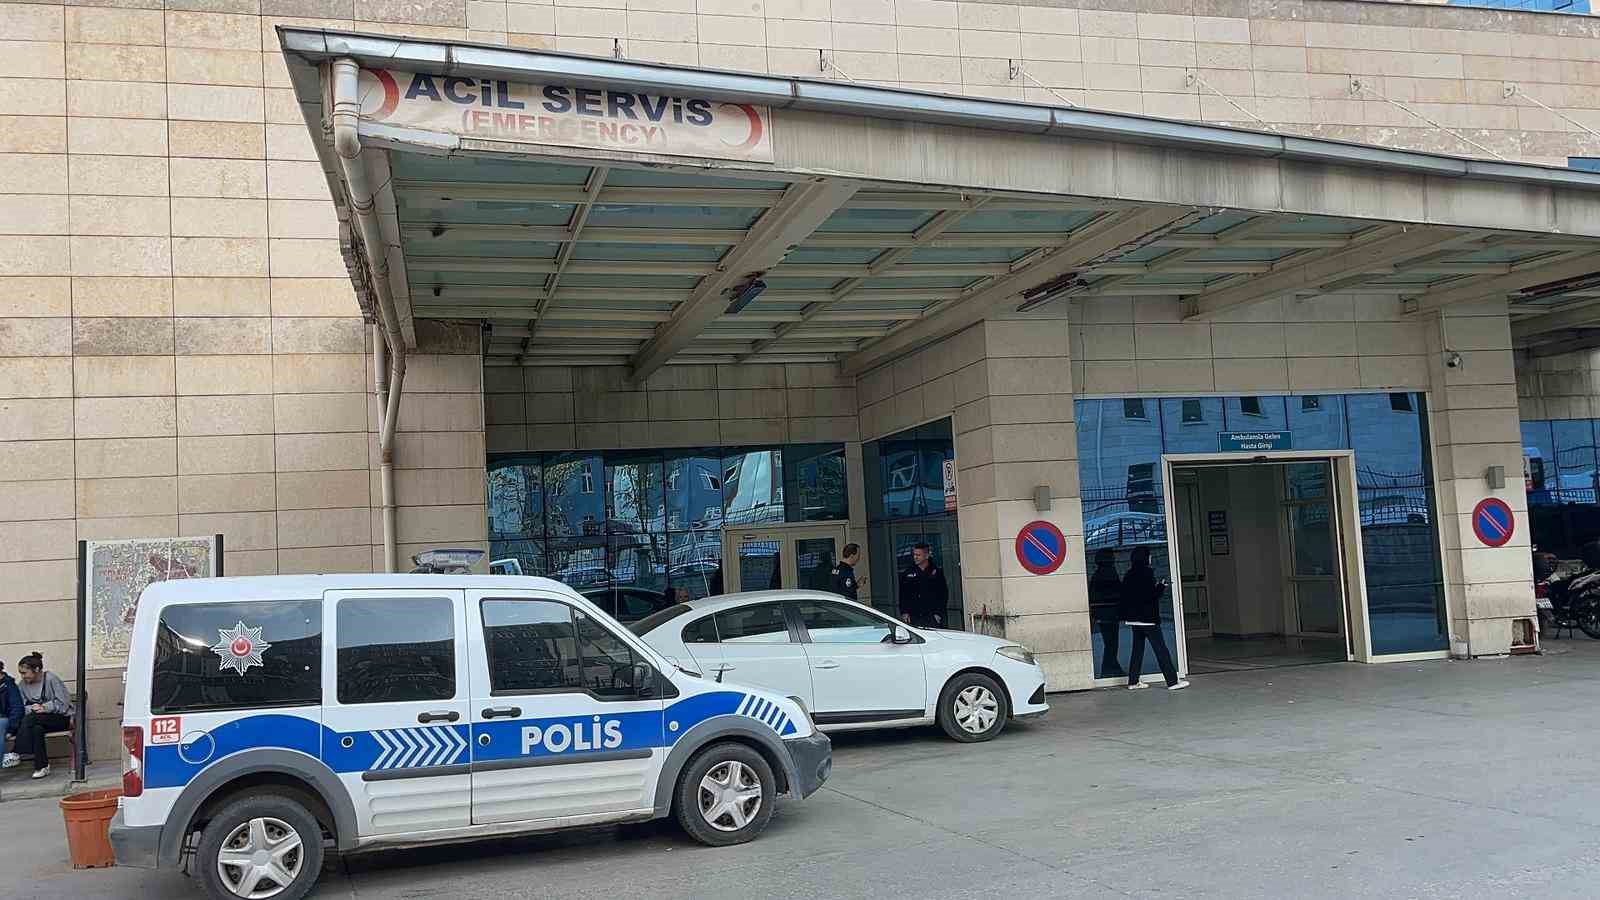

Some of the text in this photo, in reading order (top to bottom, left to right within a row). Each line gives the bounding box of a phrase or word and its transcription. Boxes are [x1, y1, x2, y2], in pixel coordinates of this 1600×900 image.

[463, 109, 668, 146] (EMERGENCY)
[154, 719, 177, 734] 112
[520, 715, 623, 755] POLİS
